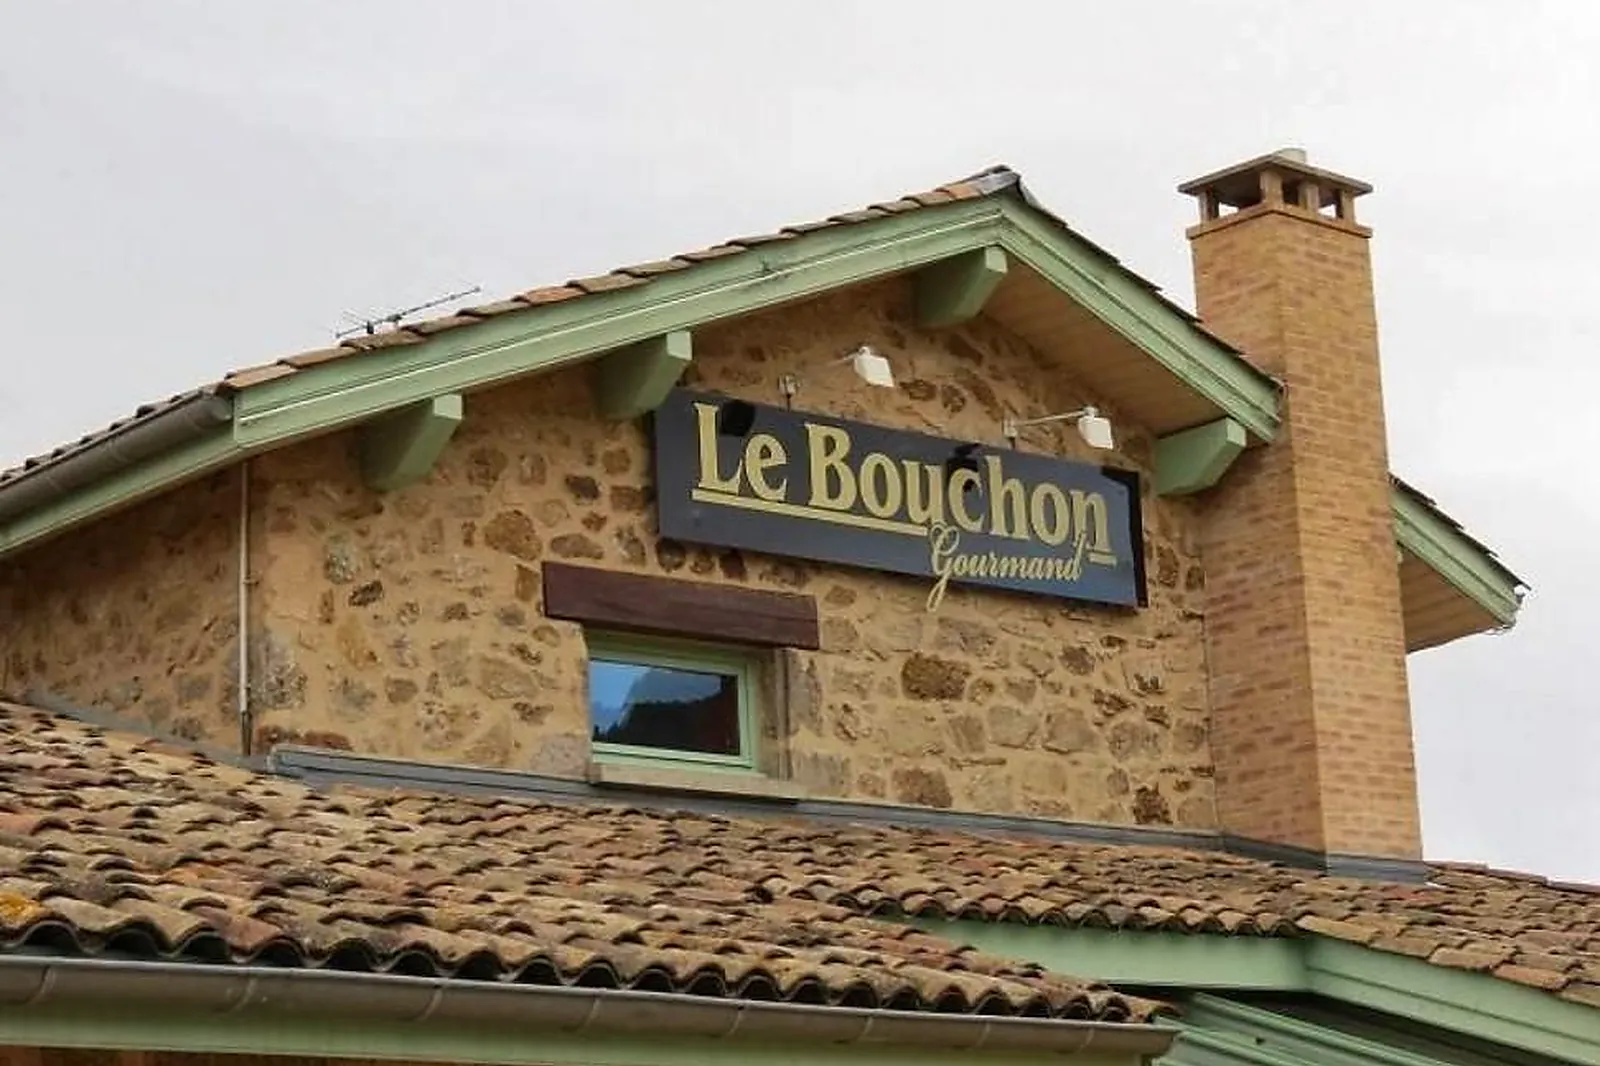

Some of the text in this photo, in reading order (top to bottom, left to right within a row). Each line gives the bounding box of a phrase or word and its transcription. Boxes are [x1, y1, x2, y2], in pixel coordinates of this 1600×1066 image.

[693, 402, 1111, 551] Le Bouchon
[926, 521, 1086, 612] Gourmand
